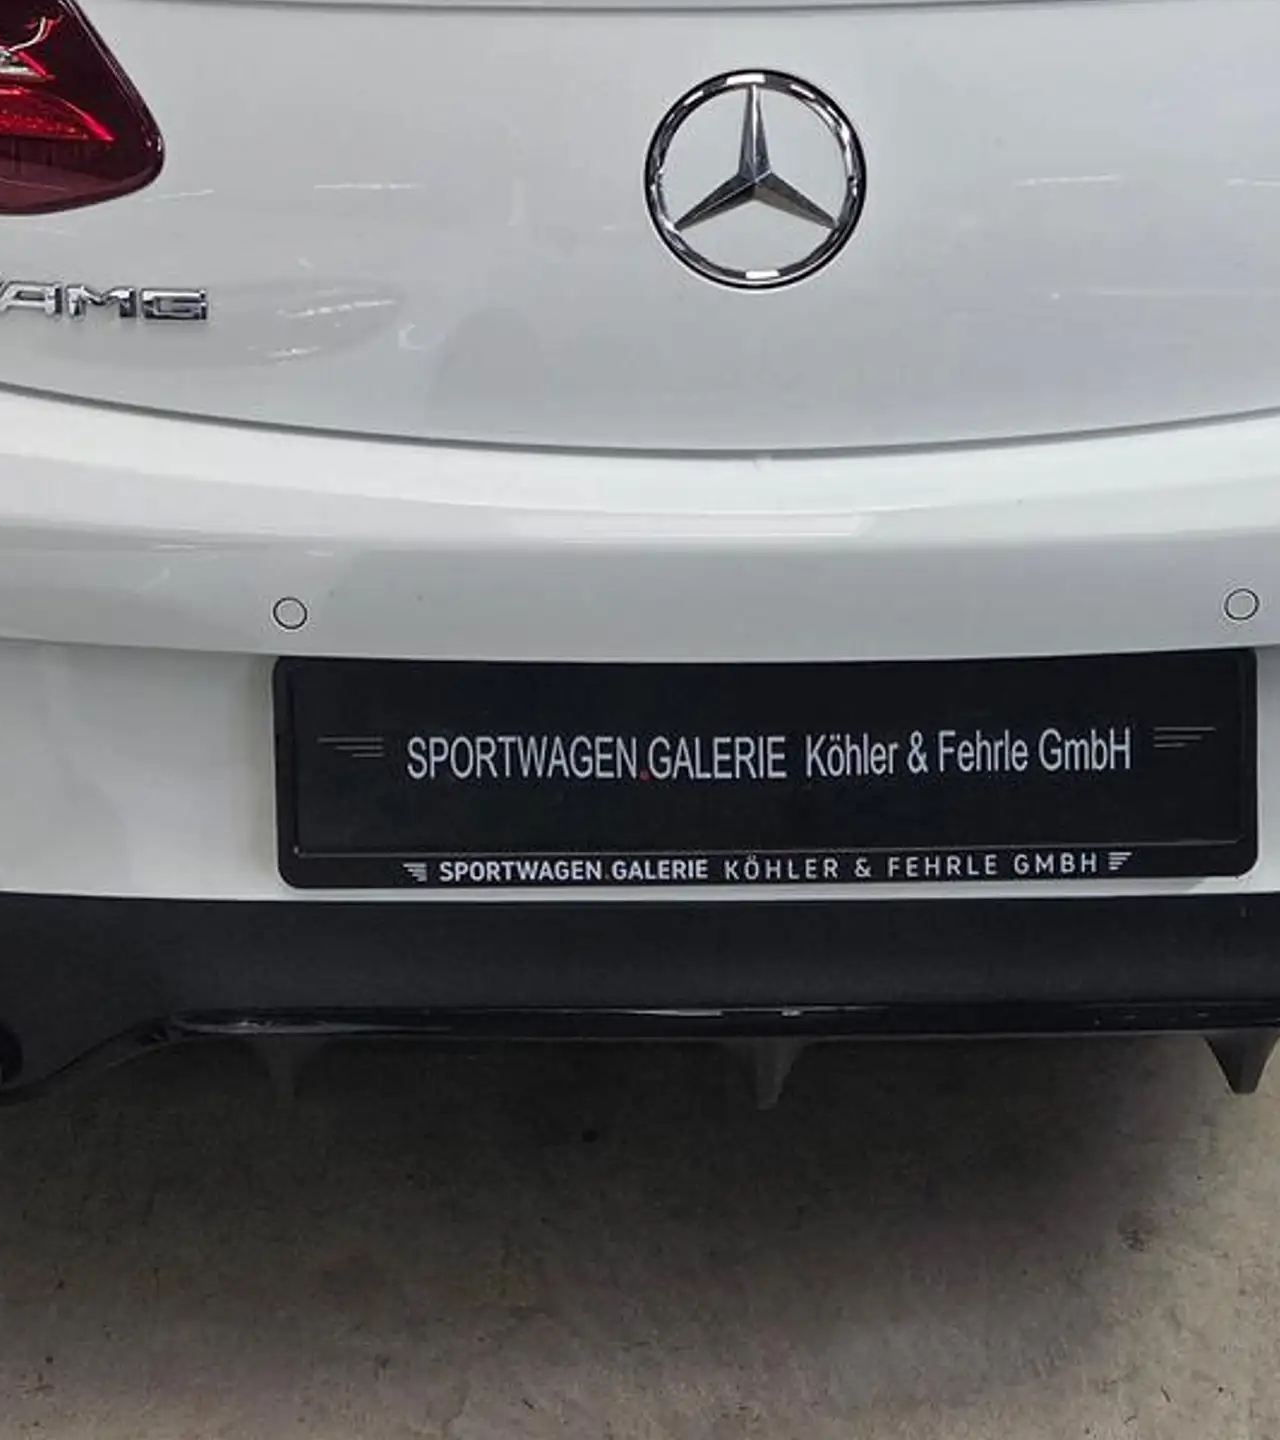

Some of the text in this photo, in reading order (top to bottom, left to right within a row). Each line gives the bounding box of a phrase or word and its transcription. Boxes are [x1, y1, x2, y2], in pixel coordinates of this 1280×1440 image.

[805, 732, 899, 777] Köhler
[907, 730, 929, 774] &
[938, 729, 1029, 773] Fehrle
[1038, 727, 1132, 772] GmbH
[725, 855, 839, 880] KÖHLER
[854, 858, 872, 878] &
[888, 854, 999, 878] FEHRLE
[1013, 852, 1098, 875] GMBH
